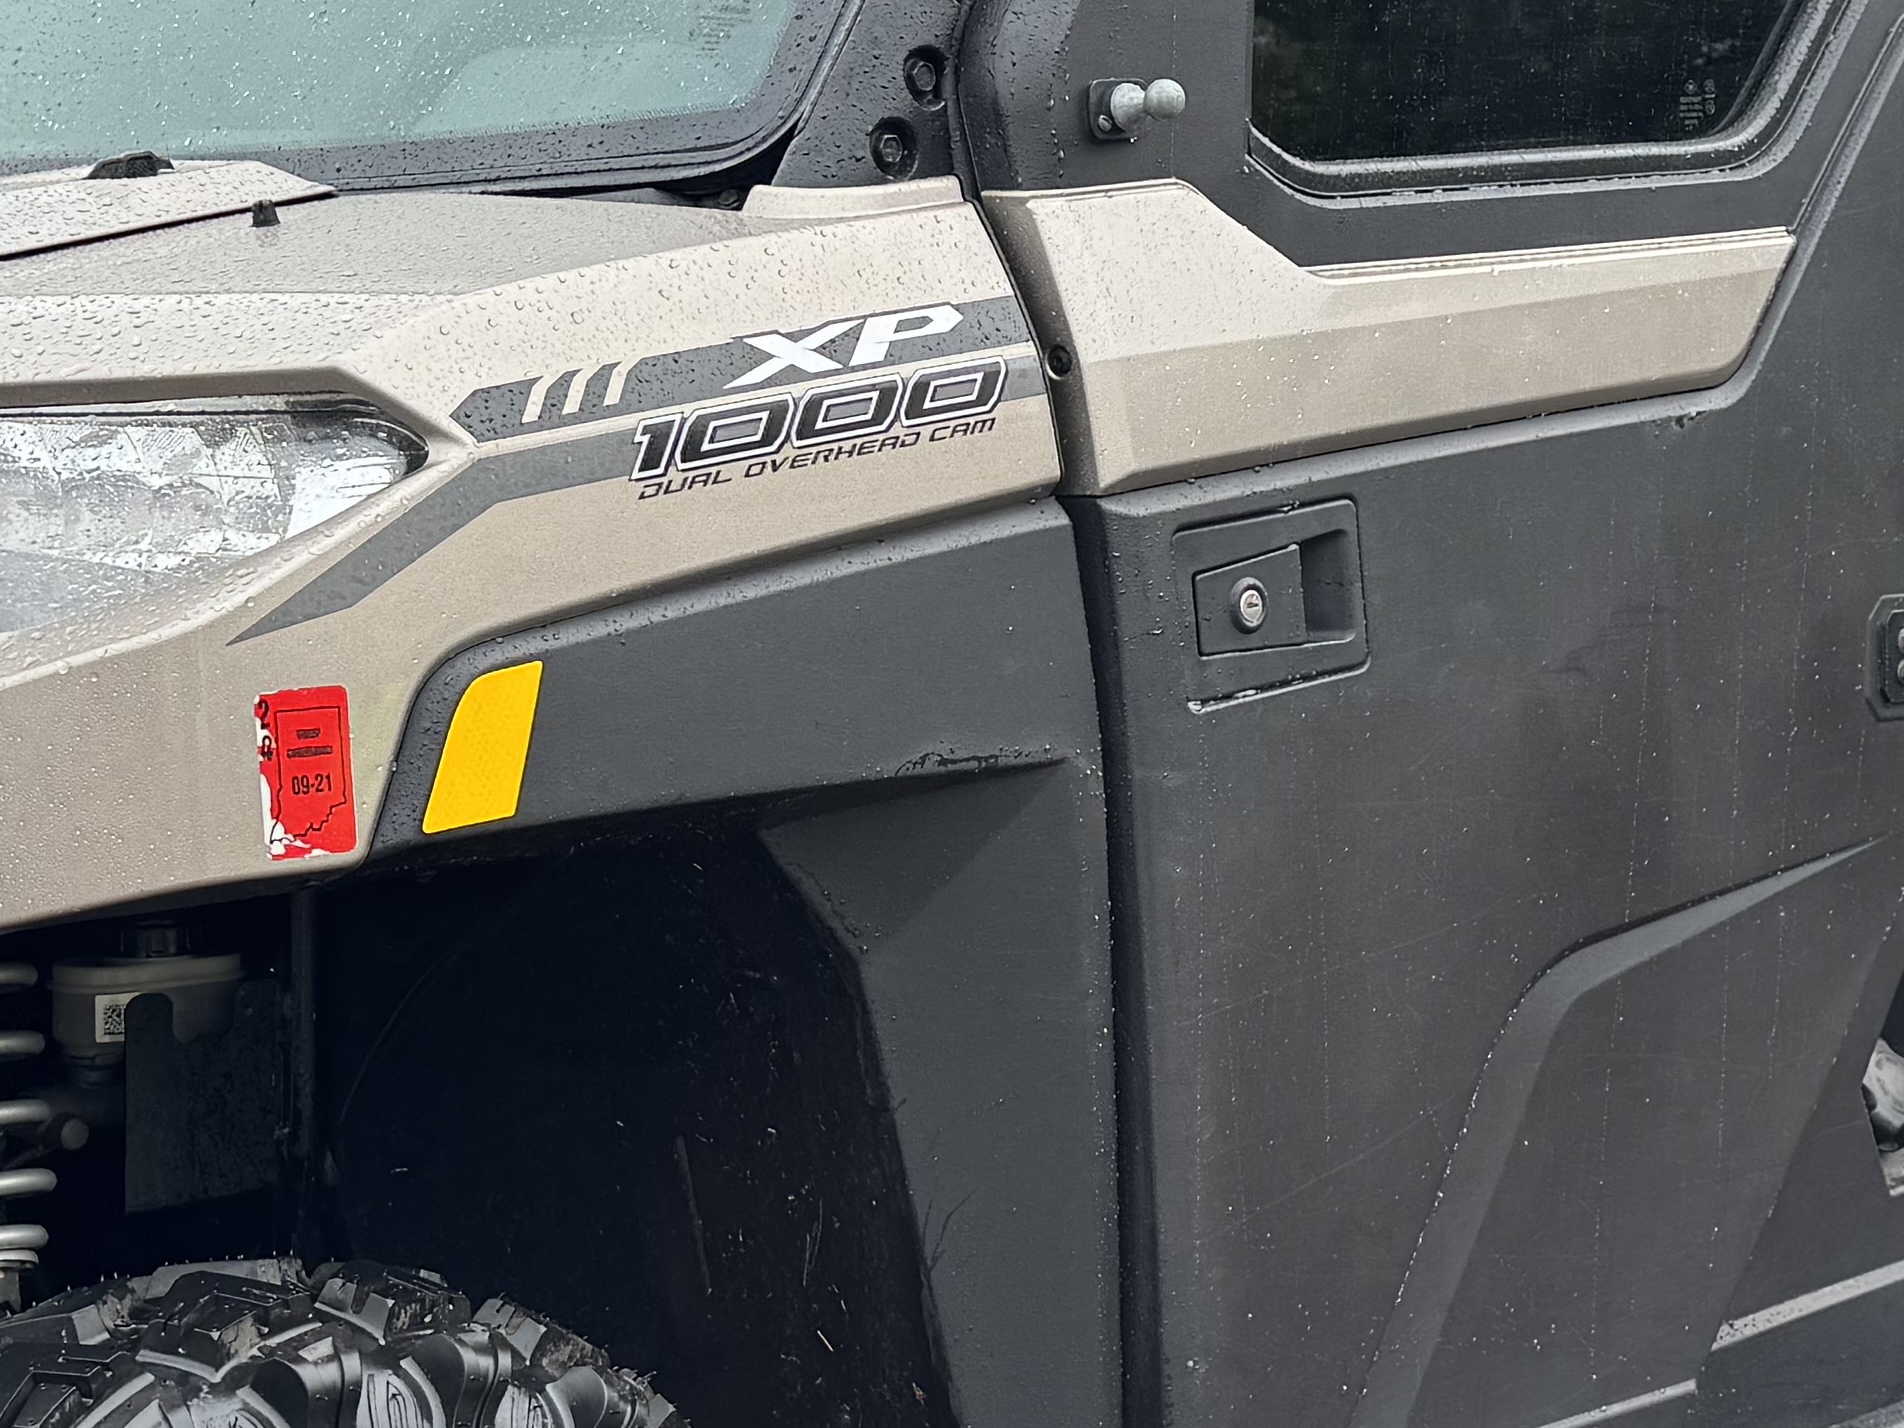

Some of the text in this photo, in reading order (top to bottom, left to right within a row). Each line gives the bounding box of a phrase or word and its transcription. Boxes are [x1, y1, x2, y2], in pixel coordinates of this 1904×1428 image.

[723, 304, 963, 389] XP
[628, 355, 1007, 481] 1000
[638, 417, 996, 500] DUAL OVERHEAD CAM
